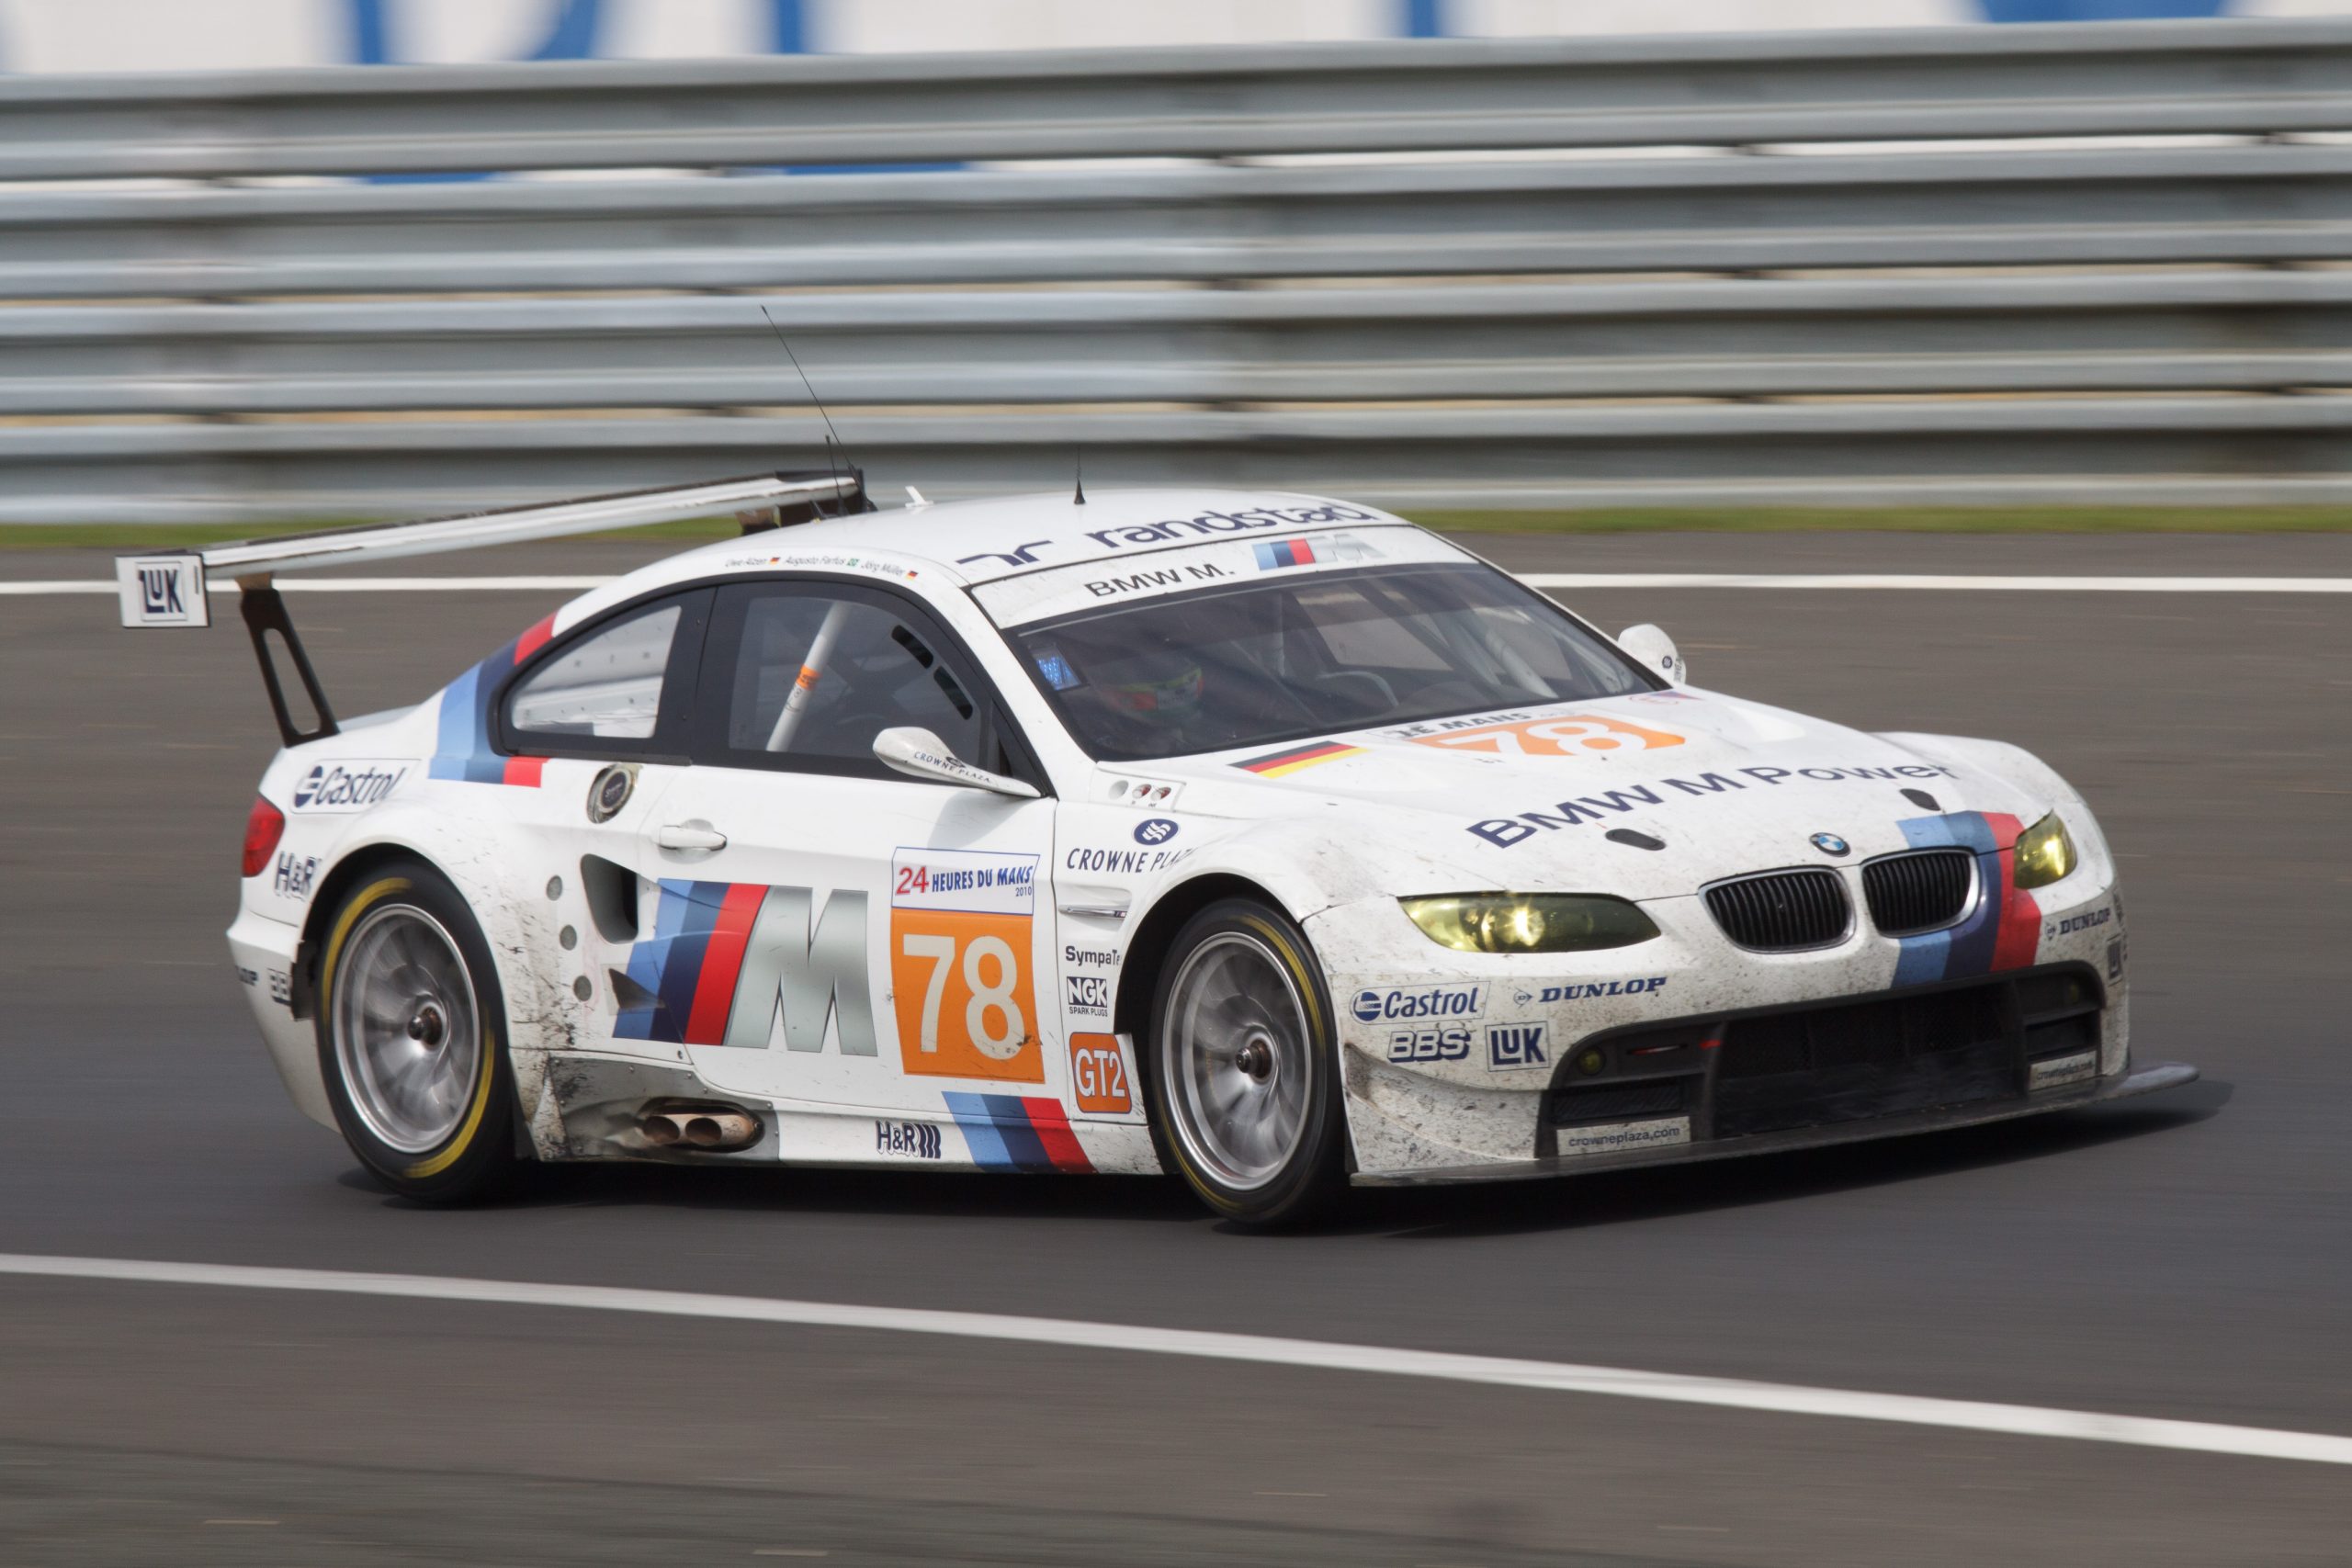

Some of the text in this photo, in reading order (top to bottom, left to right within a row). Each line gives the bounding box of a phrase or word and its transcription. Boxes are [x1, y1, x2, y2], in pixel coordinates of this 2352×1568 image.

[1086, 502, 1379, 548] randstad
[1084, 566, 1182, 597] BMW
[1439, 712, 1532, 731] MANS
[1437, 721, 1647, 759] 78
[913, 750, 991, 783] CROWNE PLAZA
[315, 766, 407, 806] Castrol
[1466, 764, 1962, 849] BMW M Power
[275, 851, 317, 897] H&R
[1067, 848, 1149, 874] CROWNE
[895, 865, 1035, 896] 24 HEURES DU MANS
[1015, 886, 1033, 897] 2010
[2059, 907, 2110, 935] DUNLOP
[903, 933, 1025, 1061] 78
[1068, 976, 1108, 1008] NGK
[1384, 987, 1478, 1019] Castrol
[1539, 976, 1668, 1002] DUNLOP
[1069, 1007, 1108, 1018] SPARK PLUGS
[1387, 1028, 1471, 1063] BBS
[1075, 1048, 1126, 1099] GT2
[876, 1120, 919, 1156] H&R
[1568, 1125, 1680, 1148] crowneplaza.com
